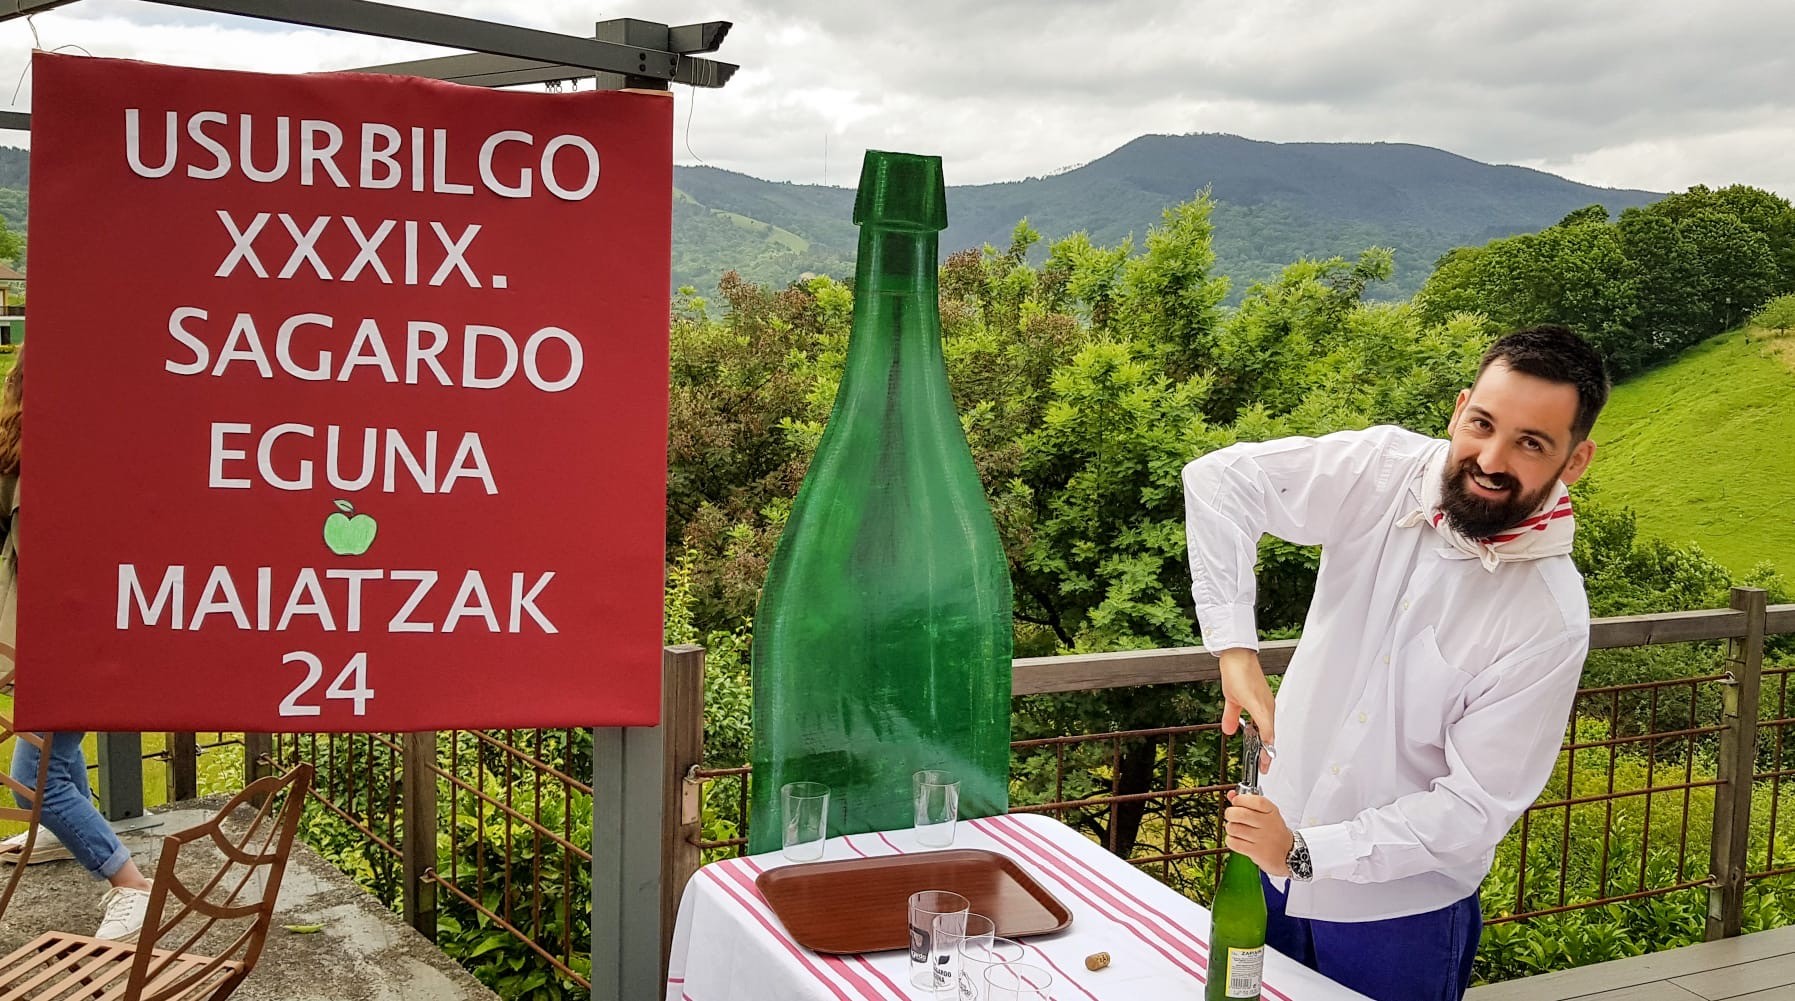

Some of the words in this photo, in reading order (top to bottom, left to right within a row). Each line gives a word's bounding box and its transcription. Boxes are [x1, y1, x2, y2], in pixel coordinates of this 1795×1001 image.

[125, 108, 601, 202] USURBILGO
[214, 210, 509, 290] XXXIX.
[165, 306, 585, 393] SAGARDO
[208, 422, 499, 496] EGUNA
[116, 563, 560, 635] MAIATZAK
[278, 650, 375, 717] 24
